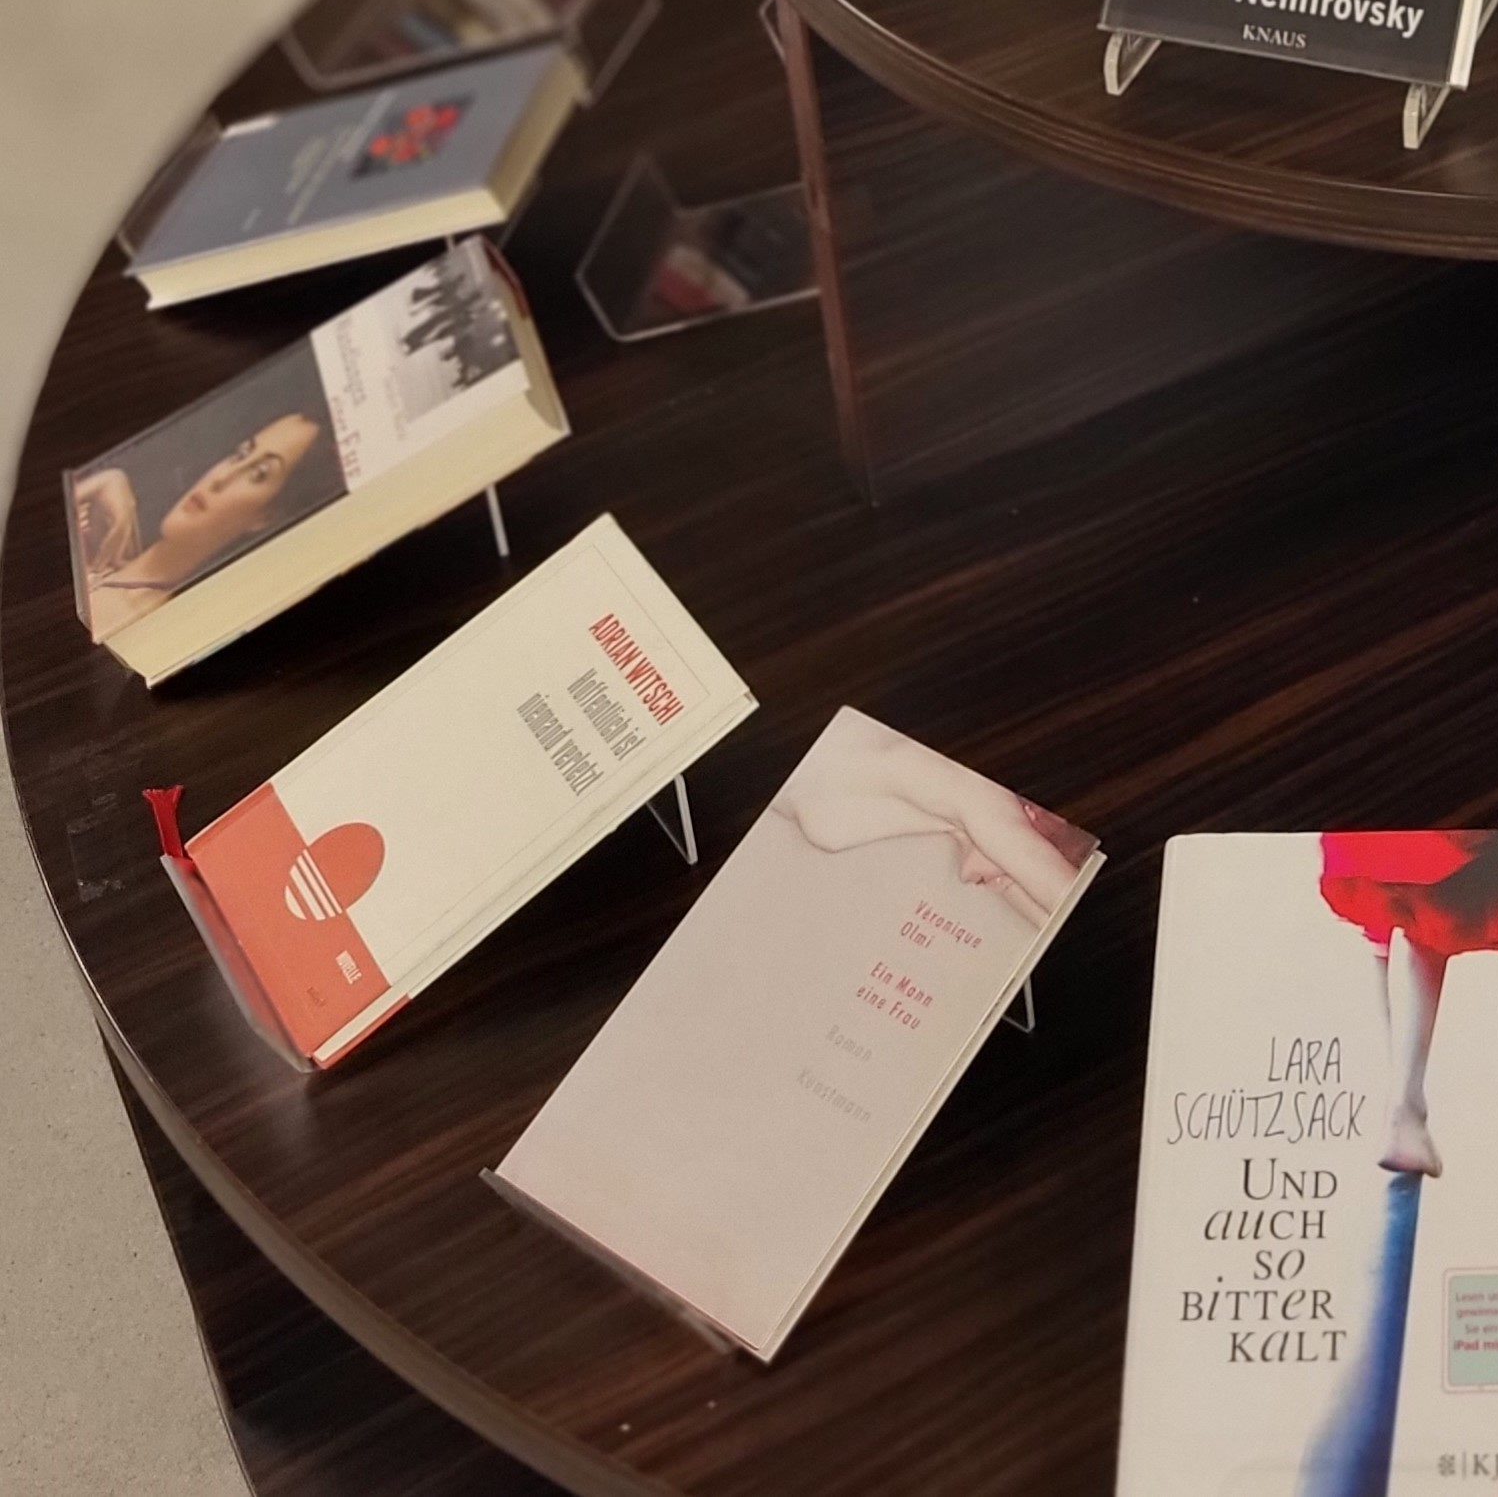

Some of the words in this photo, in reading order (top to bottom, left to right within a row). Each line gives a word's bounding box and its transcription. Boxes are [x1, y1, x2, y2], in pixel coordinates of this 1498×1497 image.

[1242, 23, 1308, 49] KNAUS
[587, 612, 640, 672] ADRIAN
[624, 655, 685, 727] WITSCHI
[566, 667, 633, 744] Hoffentlich
[609, 726, 647, 762] ist
[516, 691, 574, 752] niemand
[550, 737, 605, 798] verletzt
[900, 920, 937, 950] Olmi
[855, 984, 888, 1011] eine
[888, 1000, 922, 1031] Frau
[869, 960, 894, 986] Ein
[895, 975, 934, 1009] Mann
[825, 1023, 875, 1063] Roman
[1267, 1035, 1341, 1085] LARA
[795, 1066, 872, 1126] Kunstmann
[1166, 1088, 1367, 1145] SCHÜTZSACK
[1455, 1292, 1485, 1303] Lesen
[1453, 1339, 1480, 1351] iPad
[1464, 1323, 1480, 1334] Sie
[1482, 1324, 1498, 1334] ein
